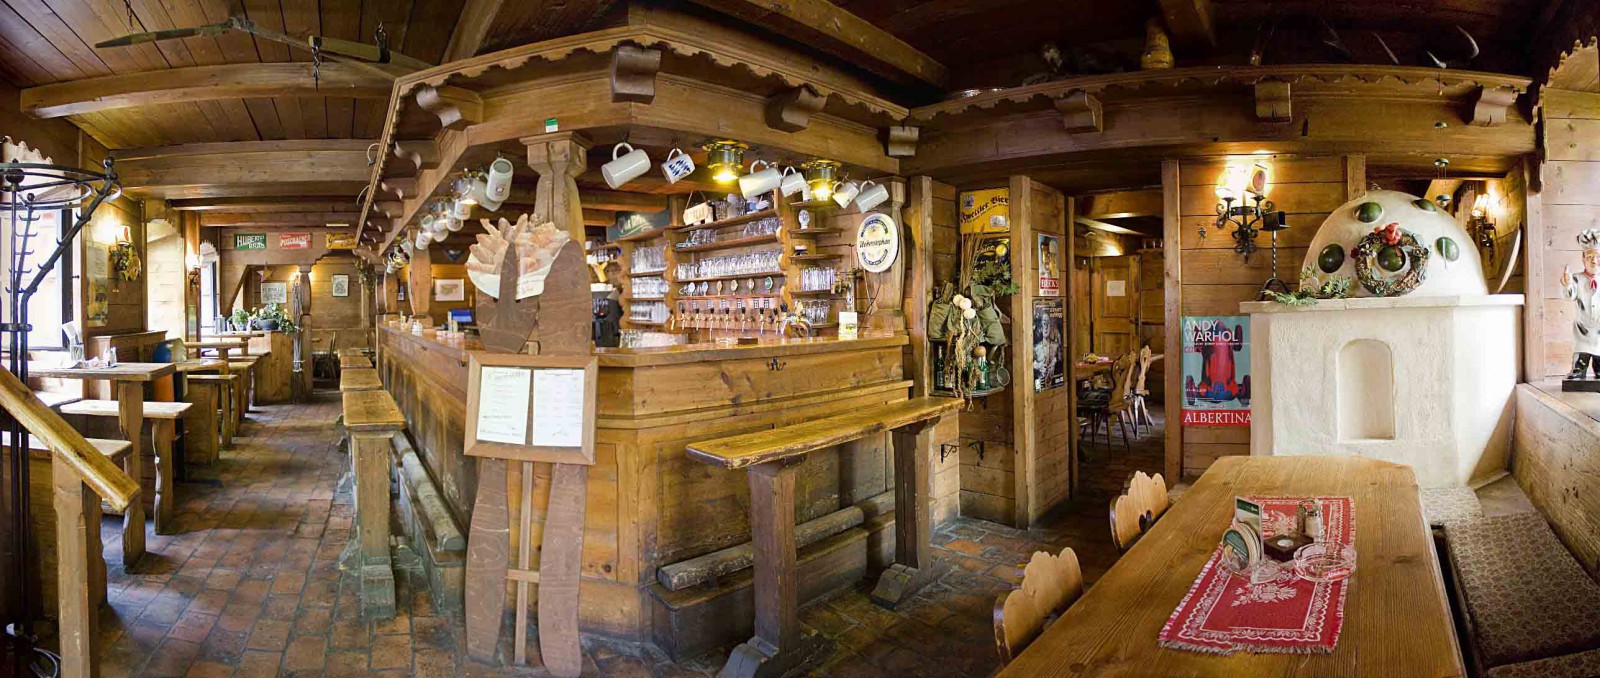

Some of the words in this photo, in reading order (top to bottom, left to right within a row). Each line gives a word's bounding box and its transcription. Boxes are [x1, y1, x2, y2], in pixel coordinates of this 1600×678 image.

[1184, 320, 1218, 331] ANDY
[1184, 331, 1239, 342] WARHOL
[1184, 412, 1251, 424] ALBERTINA
